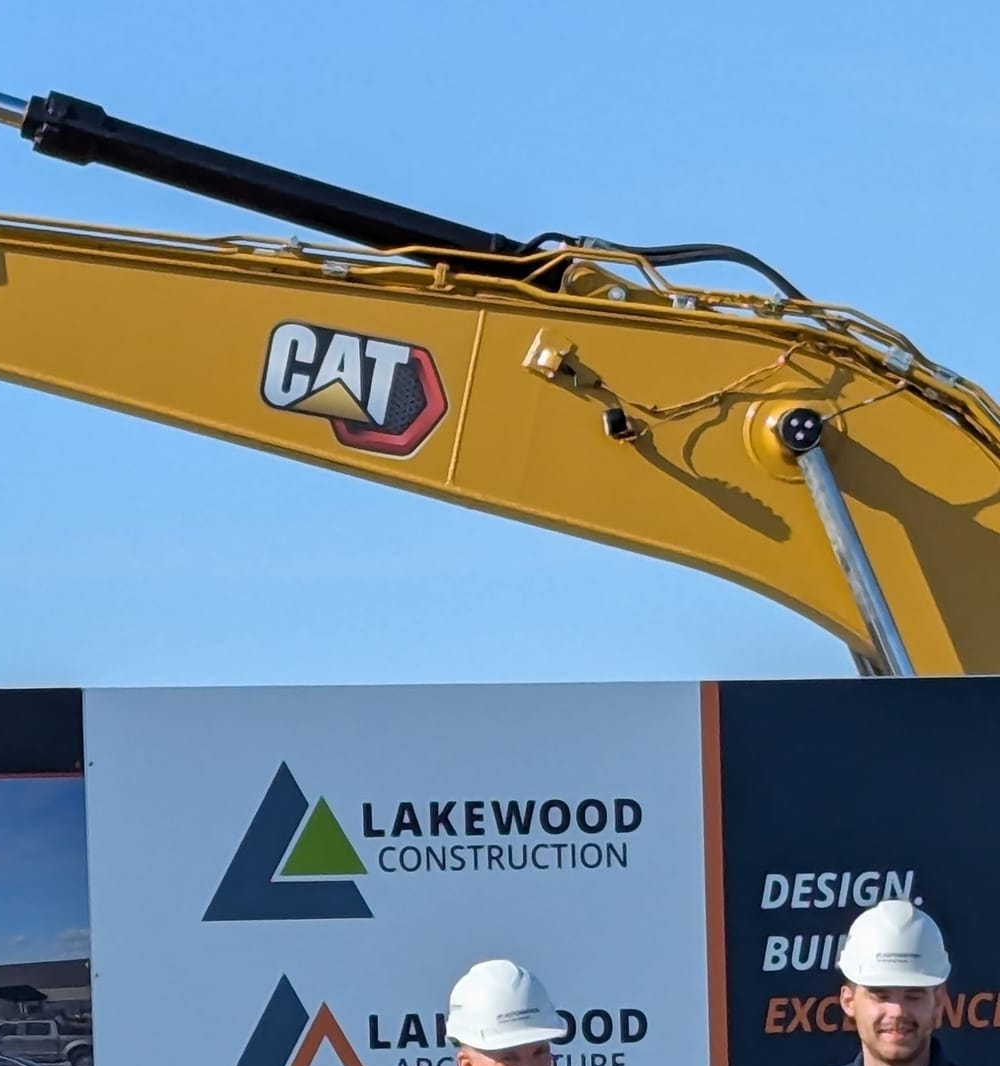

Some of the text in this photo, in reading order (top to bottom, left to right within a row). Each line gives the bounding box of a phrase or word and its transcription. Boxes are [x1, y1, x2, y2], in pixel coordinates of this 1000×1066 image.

[263, 323, 410, 426] CAT
[361, 798, 643, 837] LAKEWOOD
[378, 842, 628, 872] CONSTRUCTION
[760, 870, 924, 909] DESIGN.
[762, 933, 851, 971] BUI
[368, 1008, 648, 1049] LAKOOD
[764, 992, 1000, 1033] EXCNC
